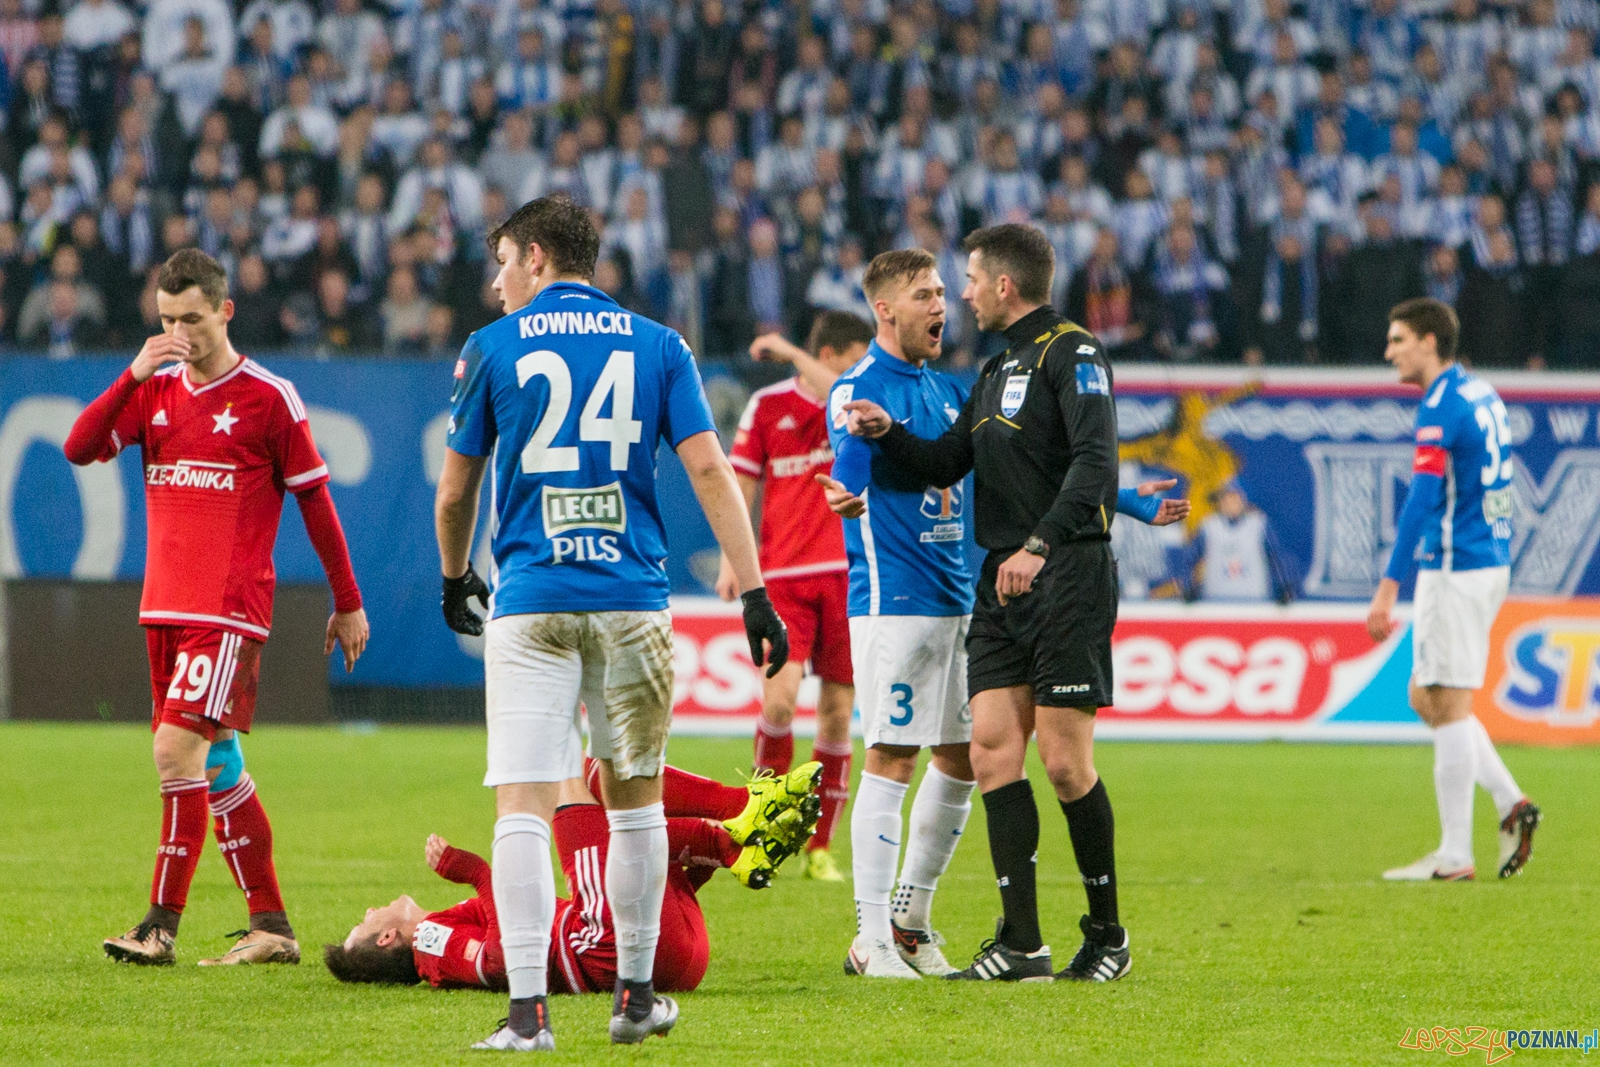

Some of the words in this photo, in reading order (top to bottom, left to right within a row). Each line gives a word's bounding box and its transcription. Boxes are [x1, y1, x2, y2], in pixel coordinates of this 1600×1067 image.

[518, 311, 633, 339] KOWNACKI
[1005, 391, 1022, 401] FIFA
[515, 349, 643, 475] 24
[146, 460, 237, 492] ELE-TONIKA
[551, 494, 618, 522] LECH
[551, 535, 622, 566] PILS
[166, 651, 213, 702] 29
[1112, 634, 1308, 715] esa
[1499, 625, 1600, 718] ST
[889, 683, 914, 726] 3
[157, 845, 188, 857] 906
[218, 836, 251, 853] 906
